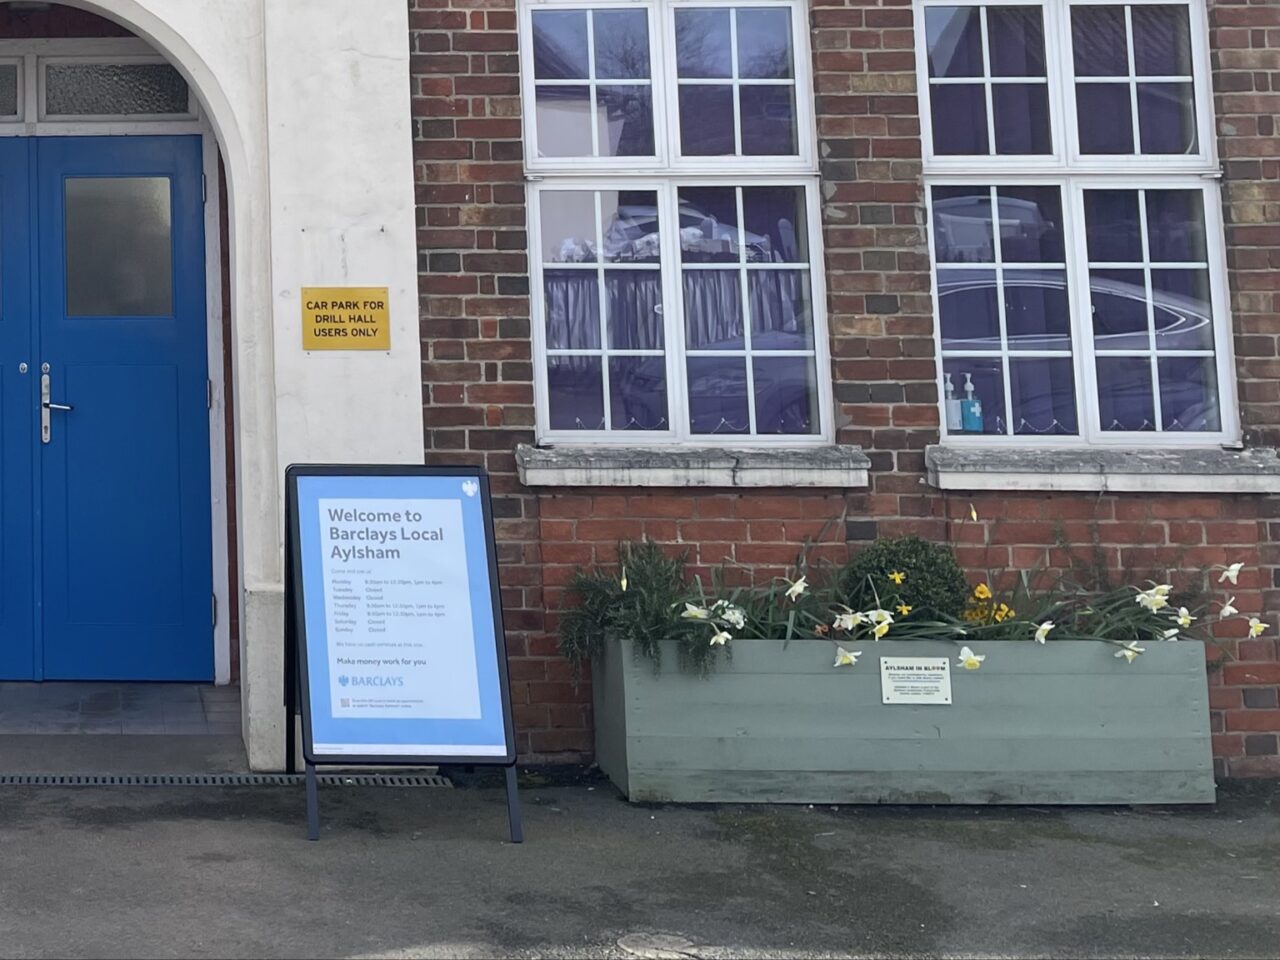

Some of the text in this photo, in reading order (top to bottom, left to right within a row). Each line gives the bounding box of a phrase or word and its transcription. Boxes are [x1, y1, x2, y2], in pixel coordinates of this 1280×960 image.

[306, 300, 385, 311] CAR PARK FOR
[315, 314, 377, 324] DRILL HALL
[313, 328, 379, 337] USERS ONLY
[328, 508, 423, 523] Welcome to
[330, 527, 444, 543] Barclays Local
[330, 546, 401, 562] Aylsham
[336, 657, 355, 665] Make
[357, 659, 380, 667] money
[401, 657, 411, 665] for
[413, 659, 427, 667] you
[351, 676, 404, 687] BARCLAYS
